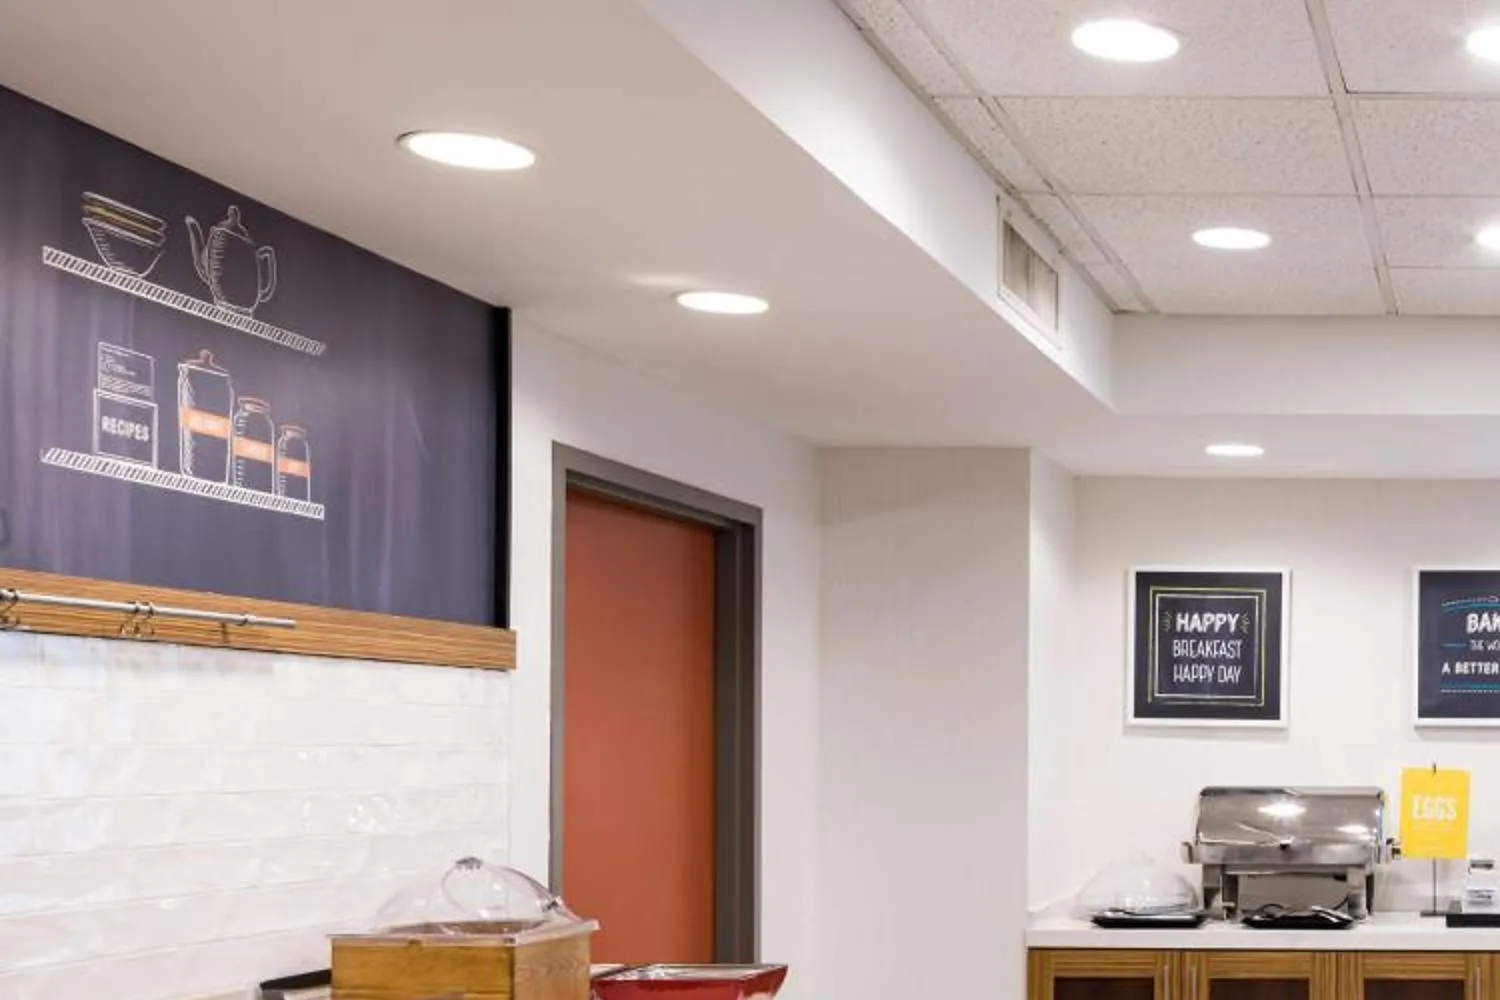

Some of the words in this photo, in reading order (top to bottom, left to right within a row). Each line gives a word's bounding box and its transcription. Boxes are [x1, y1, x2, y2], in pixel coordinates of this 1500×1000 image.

[101, 415, 150, 442] RECIPES
[1176, 612, 1240, 633] HAPPY
[1172, 639, 1243, 660] BREAKFAST
[1173, 665, 1215, 684] HAPPY
[1217, 665, 1243, 684] DAY
[1441, 662, 1451, 675] A
[1455, 662, 1499, 675] BETTER
[1412, 794, 1457, 821] EGGS
